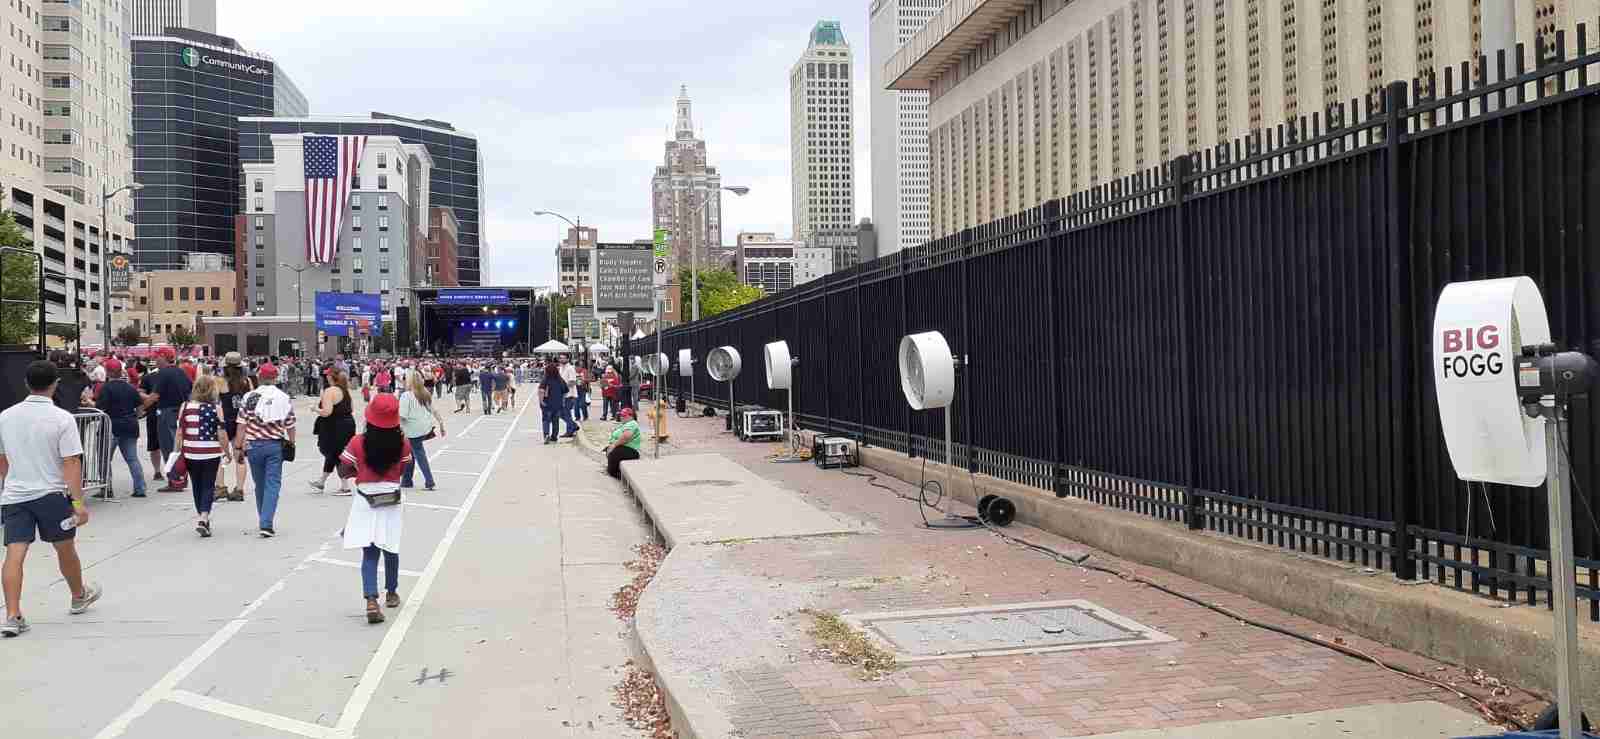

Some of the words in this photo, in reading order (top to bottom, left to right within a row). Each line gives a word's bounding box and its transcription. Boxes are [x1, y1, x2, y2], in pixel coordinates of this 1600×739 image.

[202, 55, 268, 75] CommunityCare
[1443, 325, 1499, 353] BIG
[1443, 352, 1503, 378] FOGG
